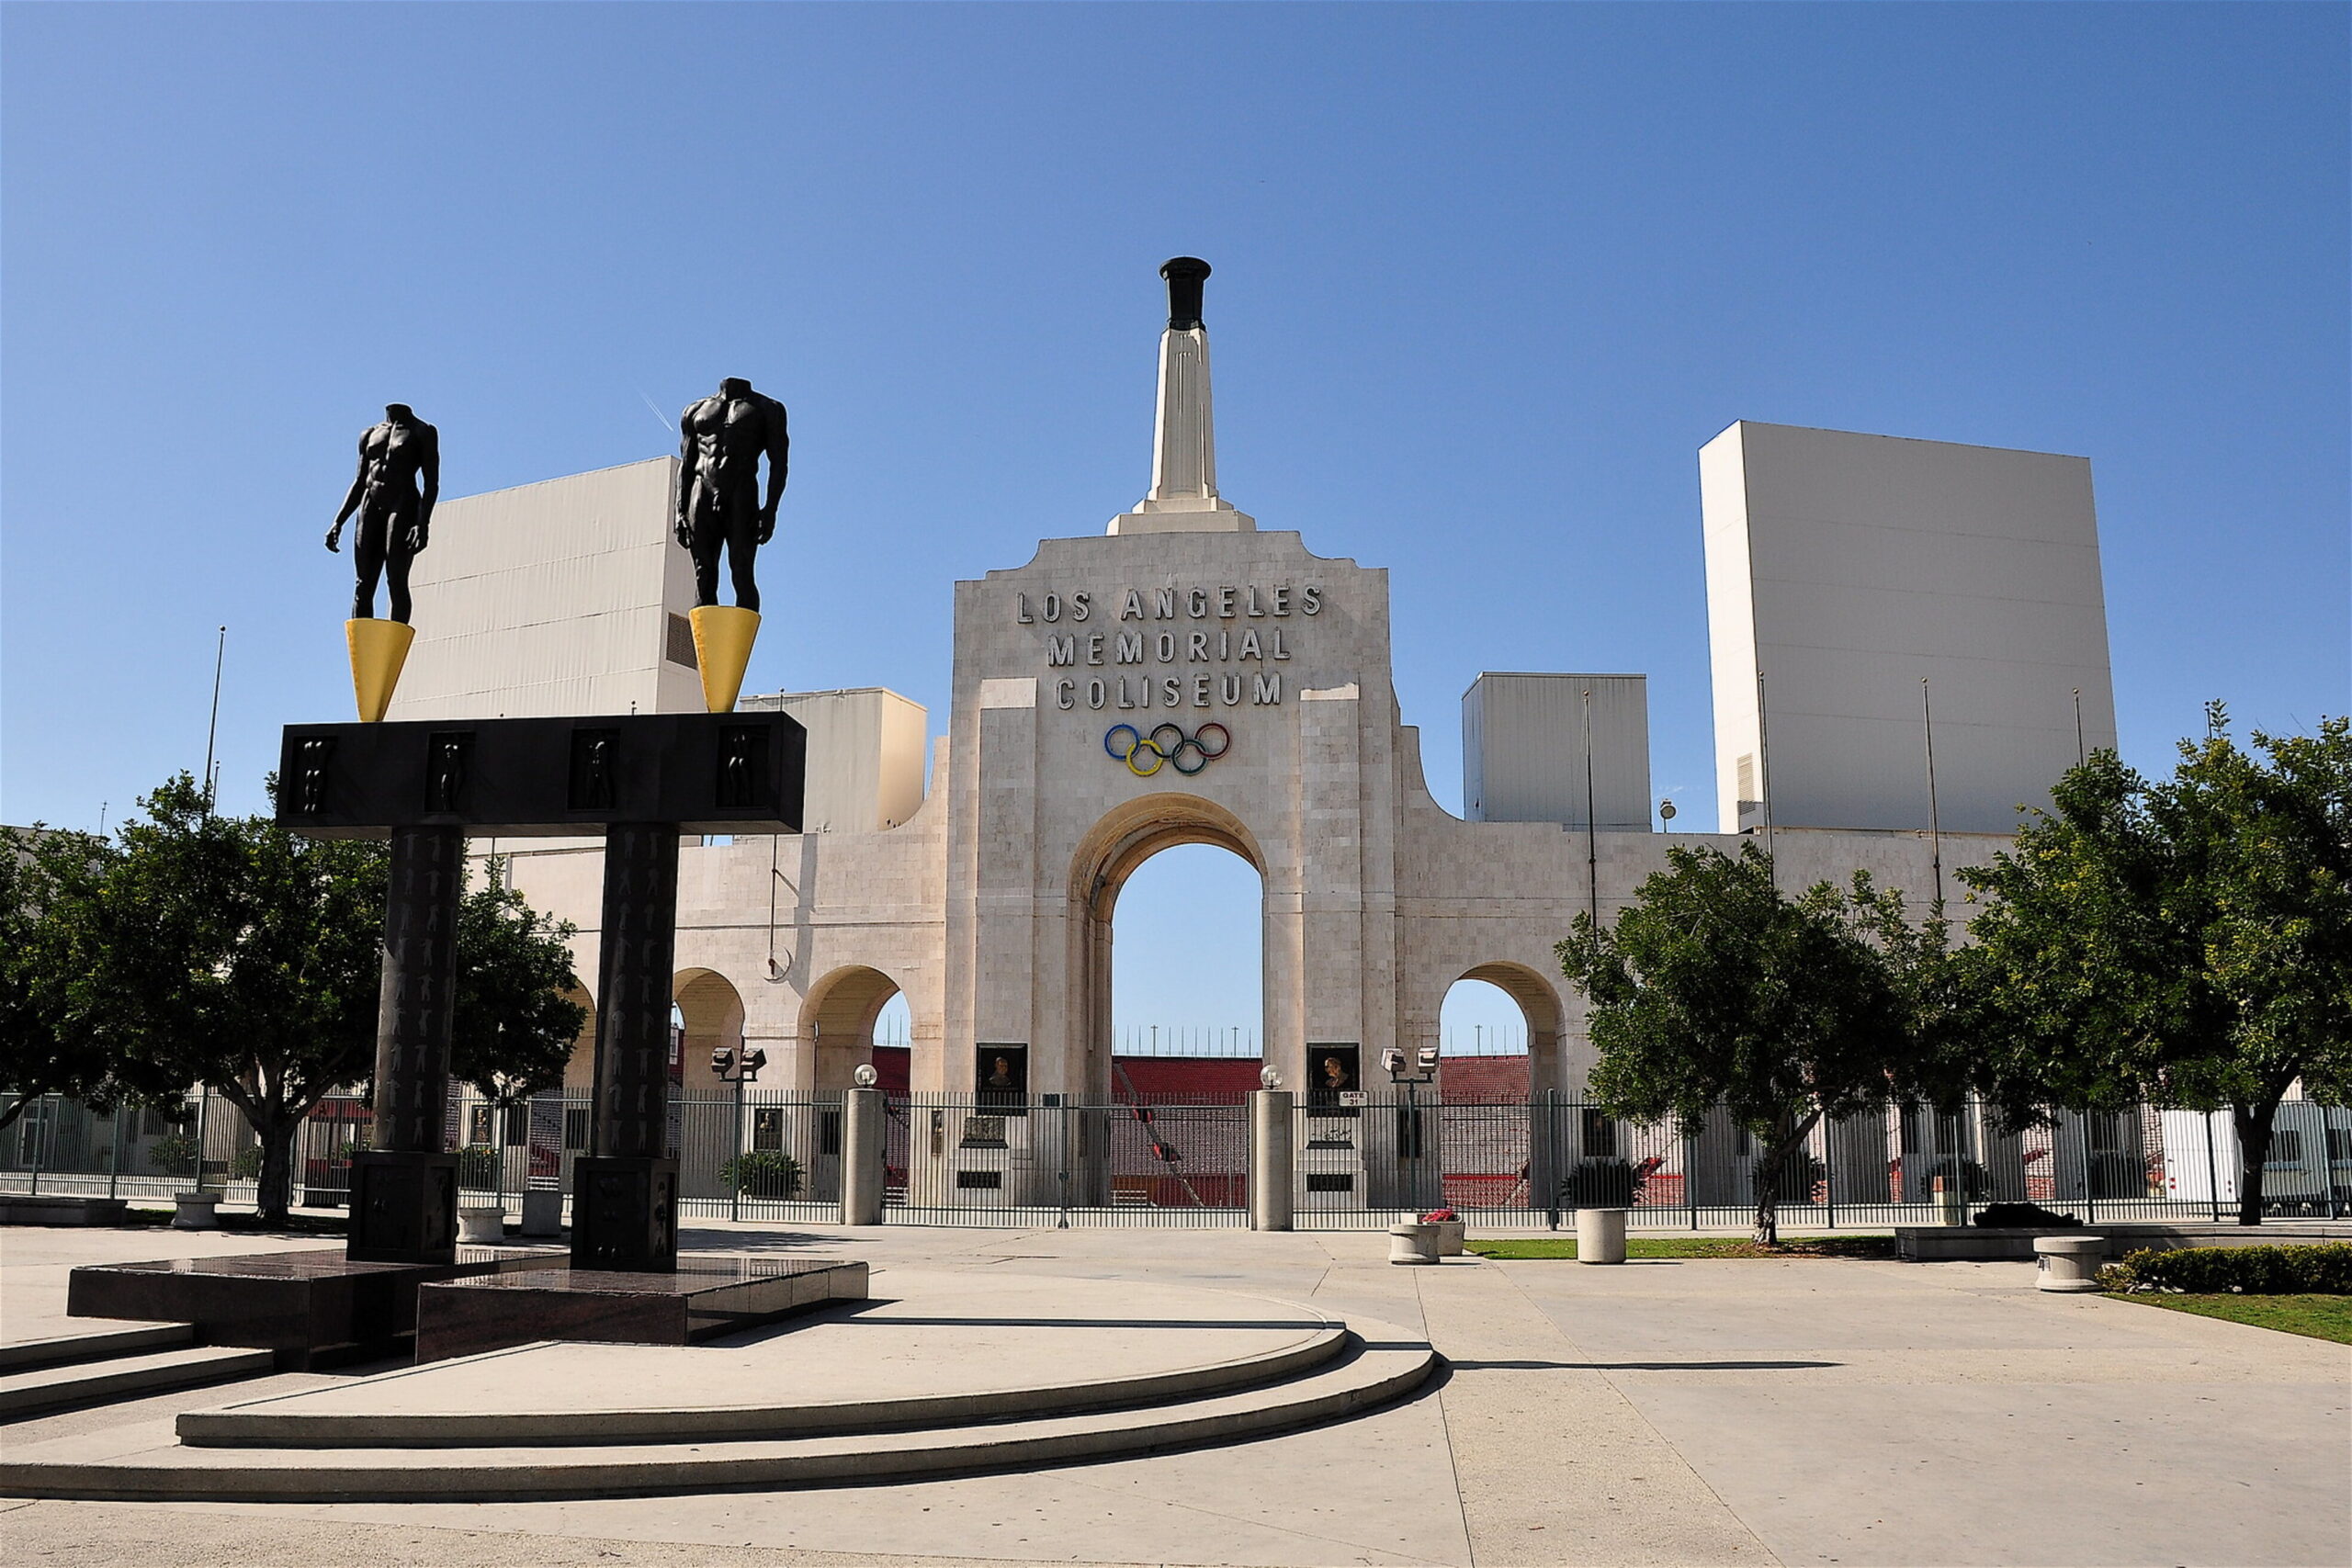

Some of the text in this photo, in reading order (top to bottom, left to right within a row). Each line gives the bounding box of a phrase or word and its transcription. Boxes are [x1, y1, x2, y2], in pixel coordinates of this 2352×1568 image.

[1017, 585, 1321, 625] LOS ANGELES
[1048, 627, 1291, 667] MEMORIAL
[1057, 672, 1282, 710] COLISEUM
